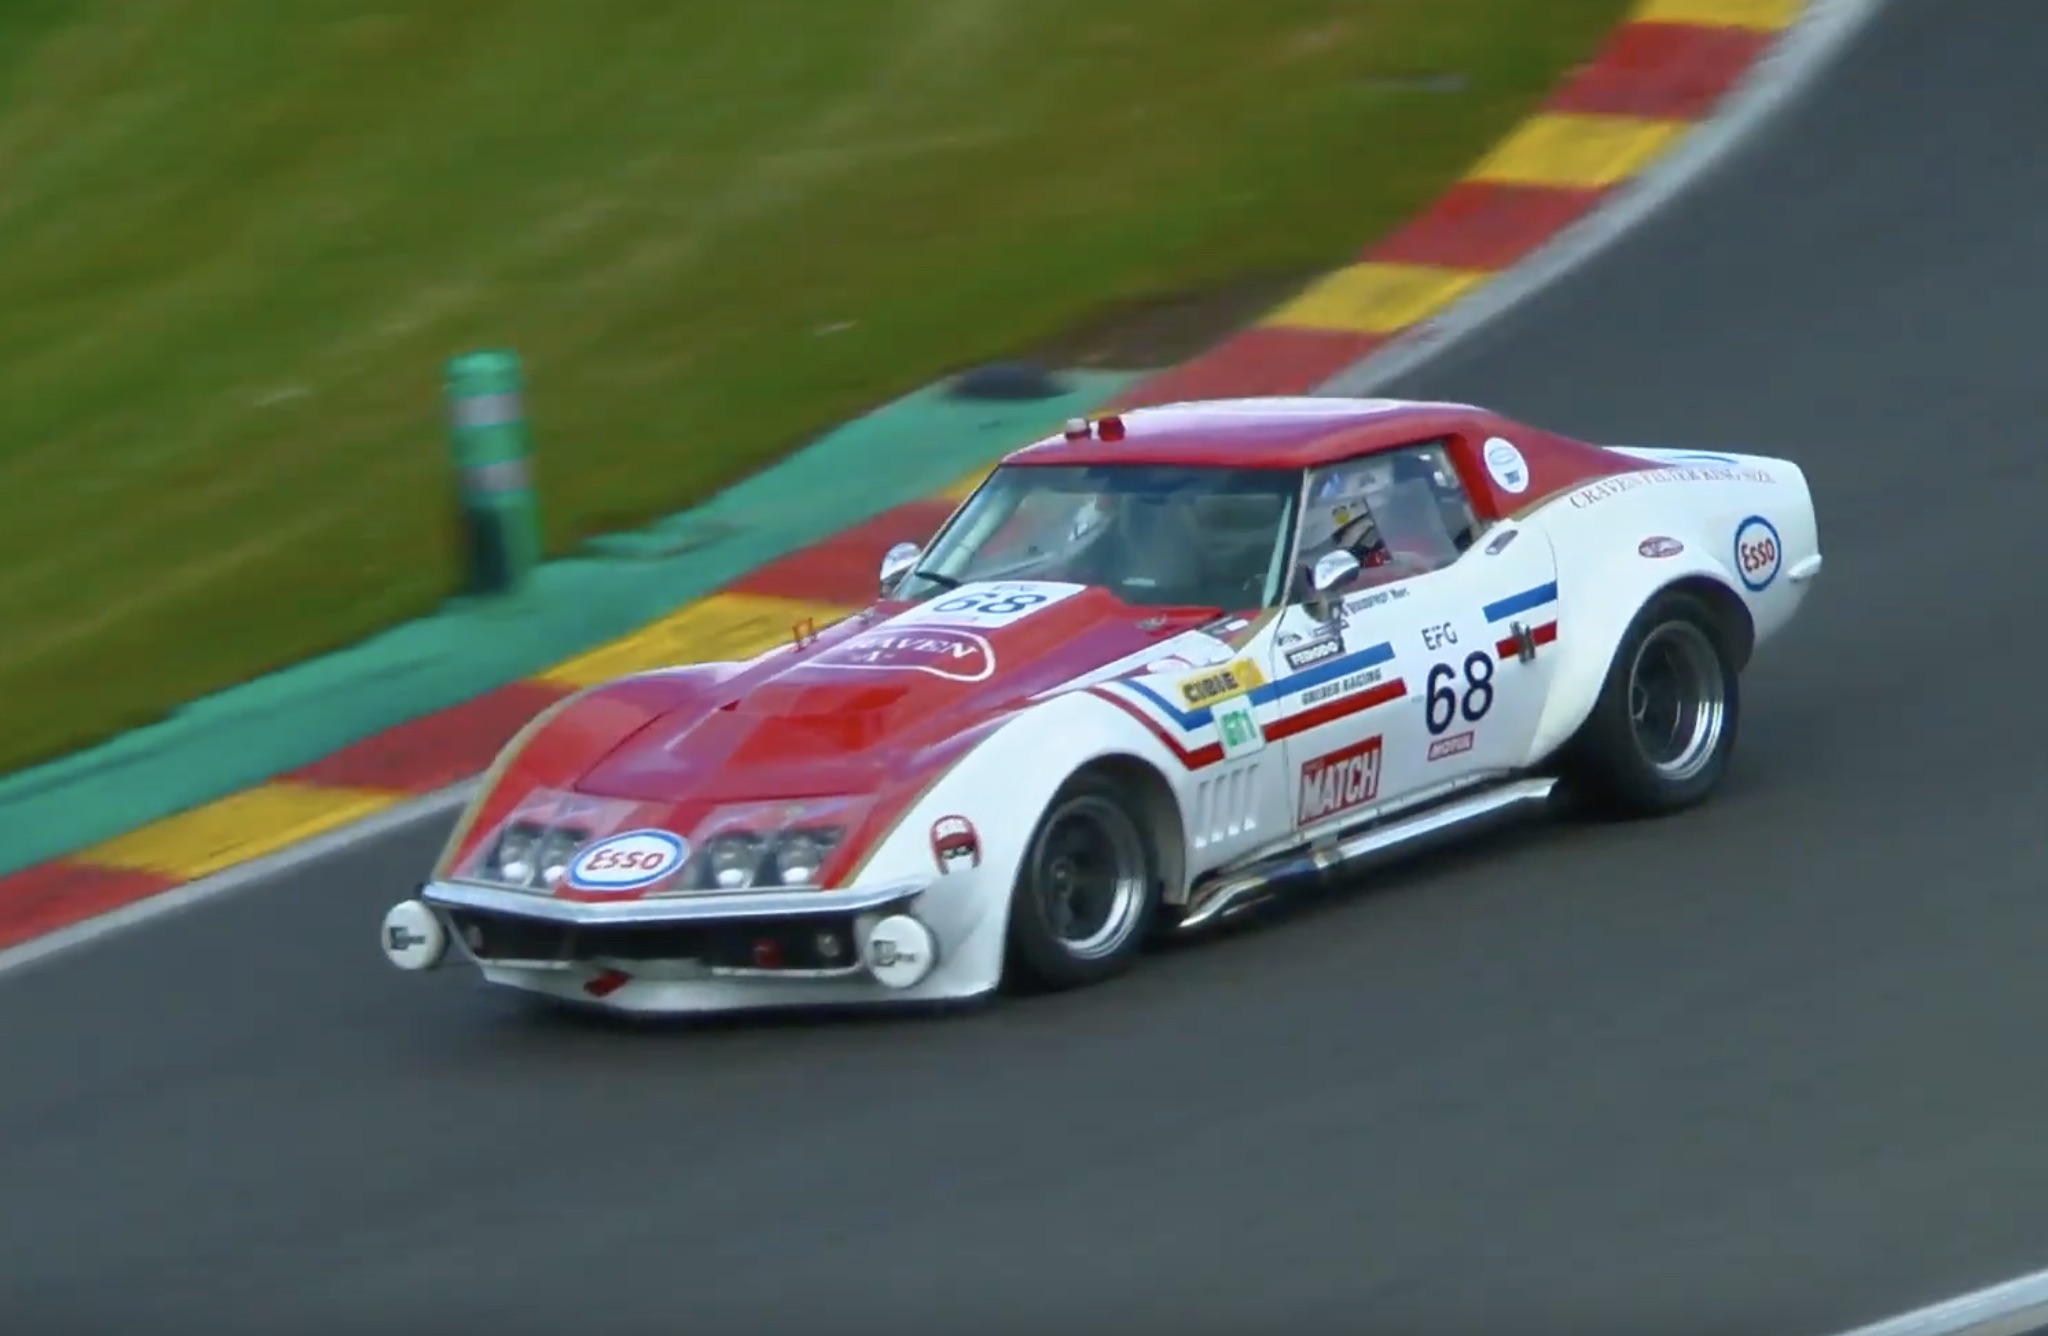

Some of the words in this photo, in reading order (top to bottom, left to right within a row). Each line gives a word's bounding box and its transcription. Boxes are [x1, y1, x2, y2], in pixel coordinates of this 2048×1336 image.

[932, 592, 1049, 614] 68
[1421, 622, 1458, 651] EFG
[1425, 650, 1494, 735] 68
[1301, 748, 1380, 821] MATCH
